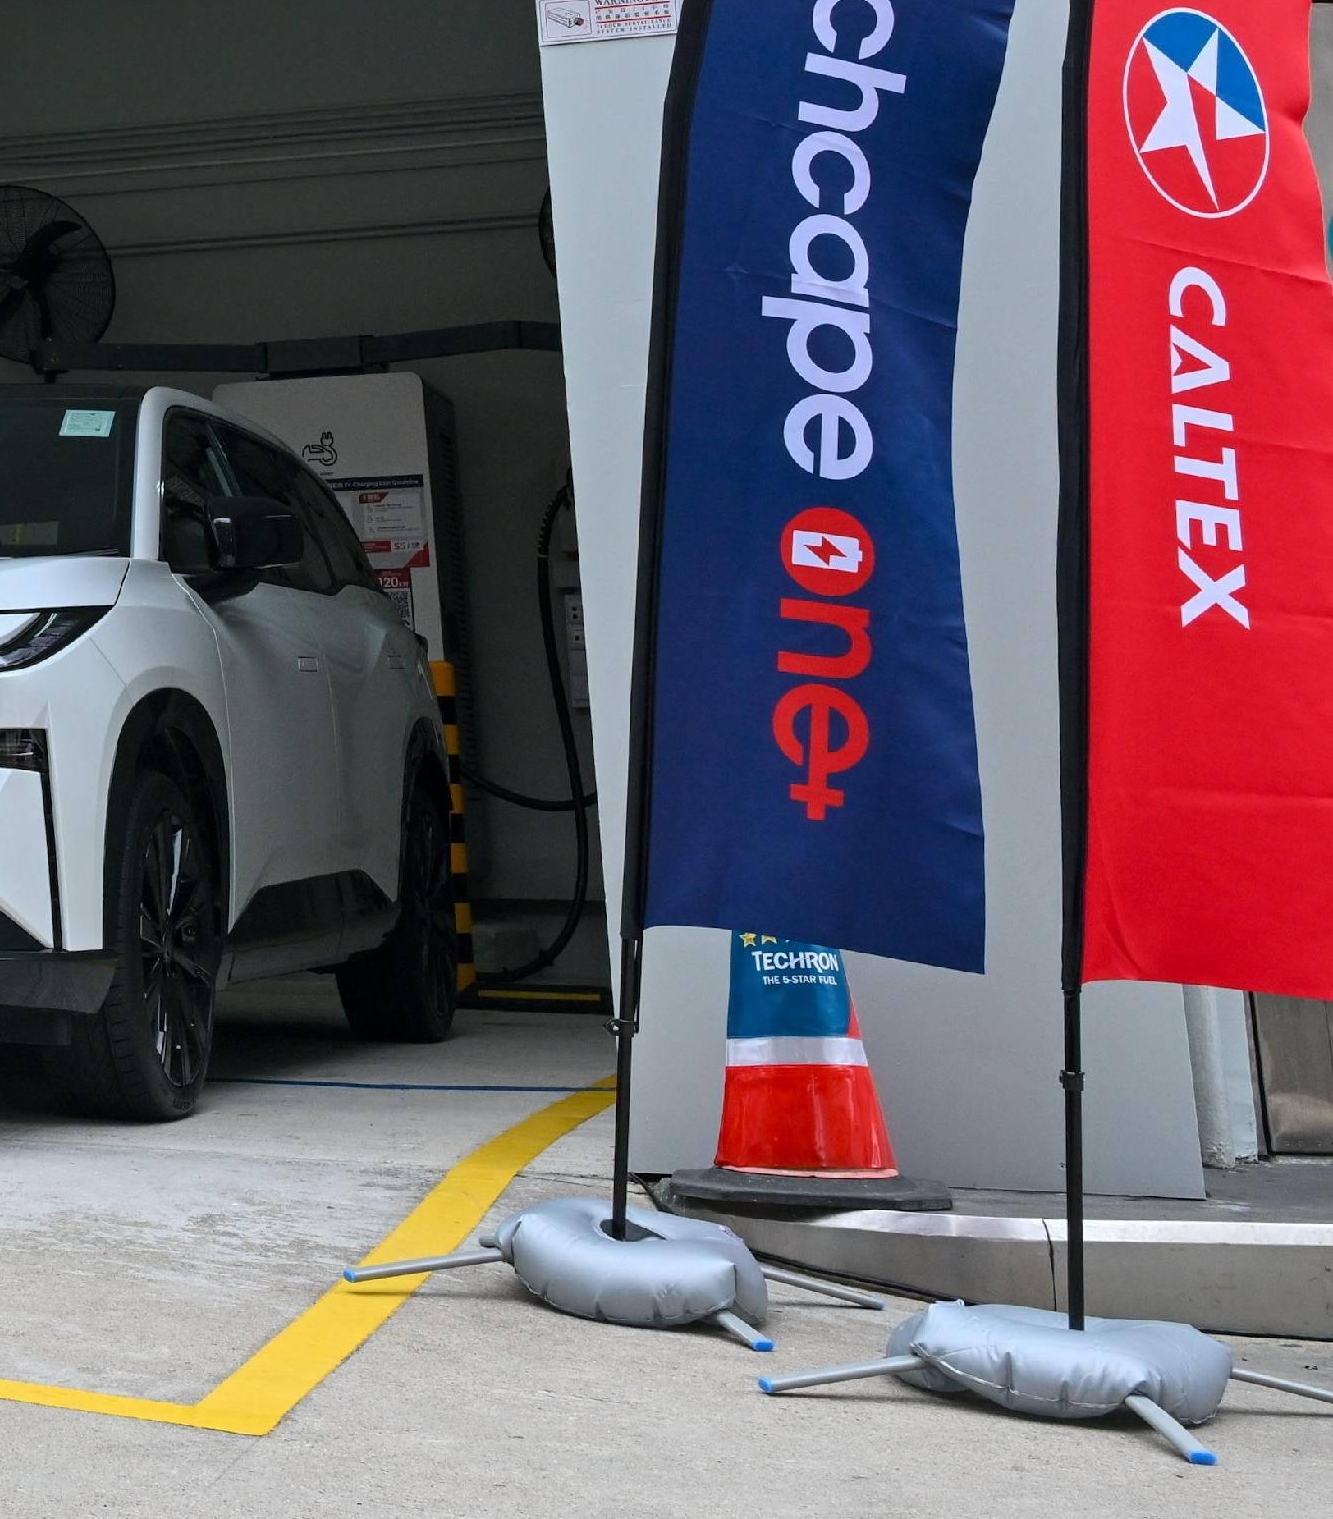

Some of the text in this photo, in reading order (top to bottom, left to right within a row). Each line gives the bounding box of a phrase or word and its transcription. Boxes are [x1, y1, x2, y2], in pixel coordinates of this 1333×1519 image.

[1168, 265, 1251, 630] CALTEX
[751, 950, 839, 973] TECHRON
[762, 975, 837, 986] THE 5-STAR FUEL
